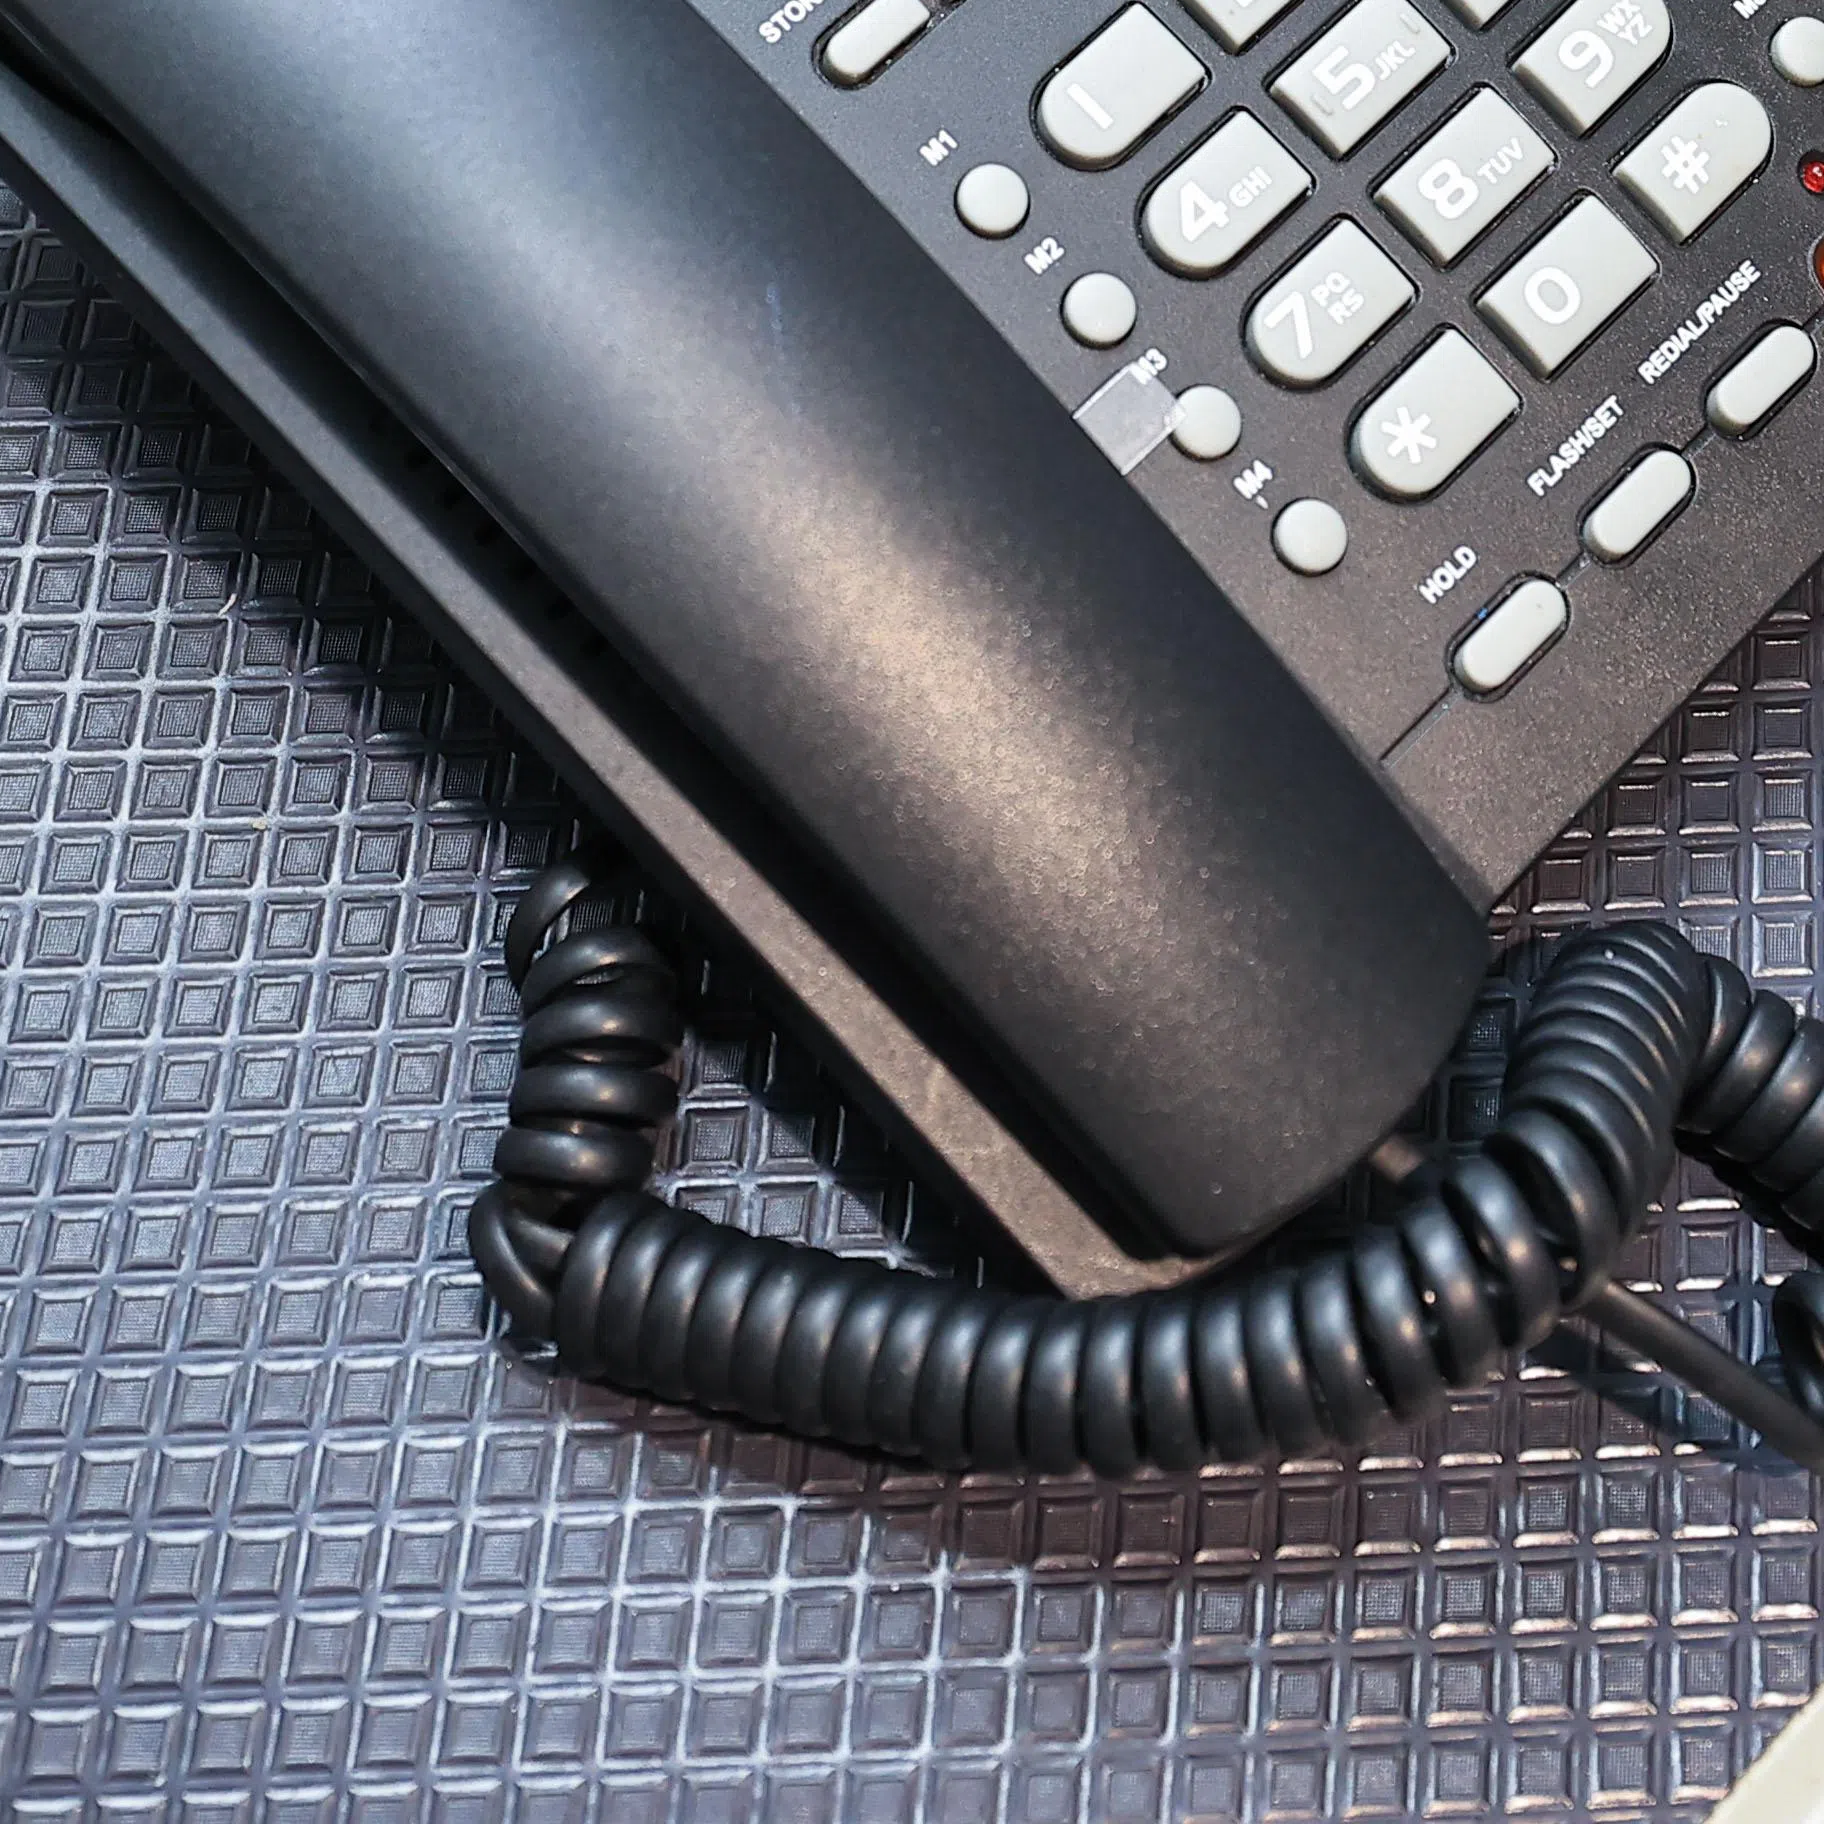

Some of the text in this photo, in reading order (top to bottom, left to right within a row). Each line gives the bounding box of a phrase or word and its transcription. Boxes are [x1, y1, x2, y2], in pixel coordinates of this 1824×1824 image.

[1557, 28, 1615, 90] 9
[1617, 12, 1654, 46] YZ
[1311, 41, 1417, 112] 5 JKL
[917, 128, 960, 168] M1
[1417, 136, 1526, 220] 8 TUV
[1178, 165, 1274, 244] 4 GHI
[1022, 235, 1066, 275] M2
[1309, 270, 1353, 307] PQ
[1327, 289, 1366, 325] RS
[1522, 265, 1582, 326] 0
[1262, 289, 1314, 360] 7
[1636, 257, 1762, 386] REDIAL/PAUSE
[1129, 346, 1169, 386] M3
[1524, 393, 1626, 498] FLASH/SET
[1232, 458, 1274, 501] M4
[1417, 544, 1480, 606] HOLD
